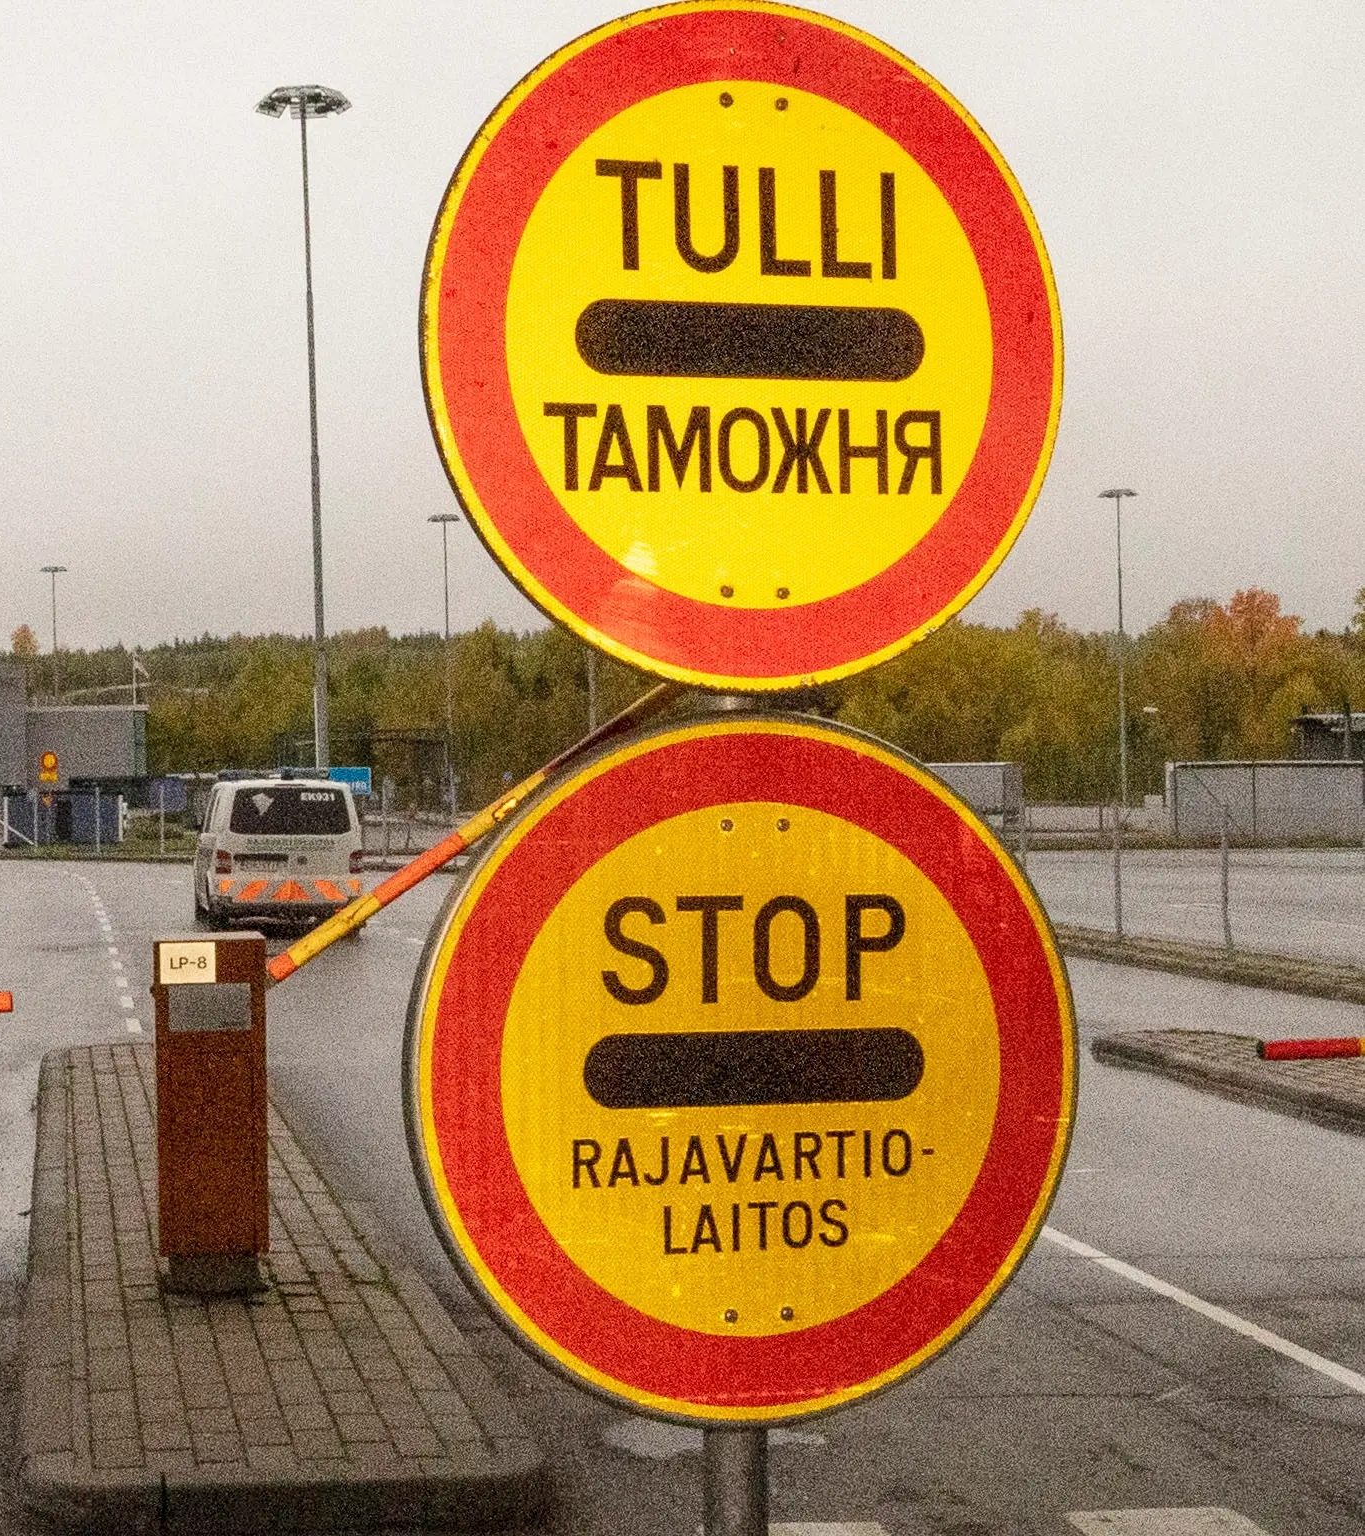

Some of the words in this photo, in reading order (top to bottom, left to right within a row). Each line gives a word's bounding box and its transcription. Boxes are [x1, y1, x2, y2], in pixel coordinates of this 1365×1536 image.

[595, 158, 897, 280] TULLI
[543, 402, 943, 495] ТАМОЖНЯ
[169, 956, 207, 970] LP-8
[601, 894, 906, 1006] STOP
[572, 1128, 935, 1190] RAJAVARTIO-
[662, 1199, 850, 1255] LAITOS
